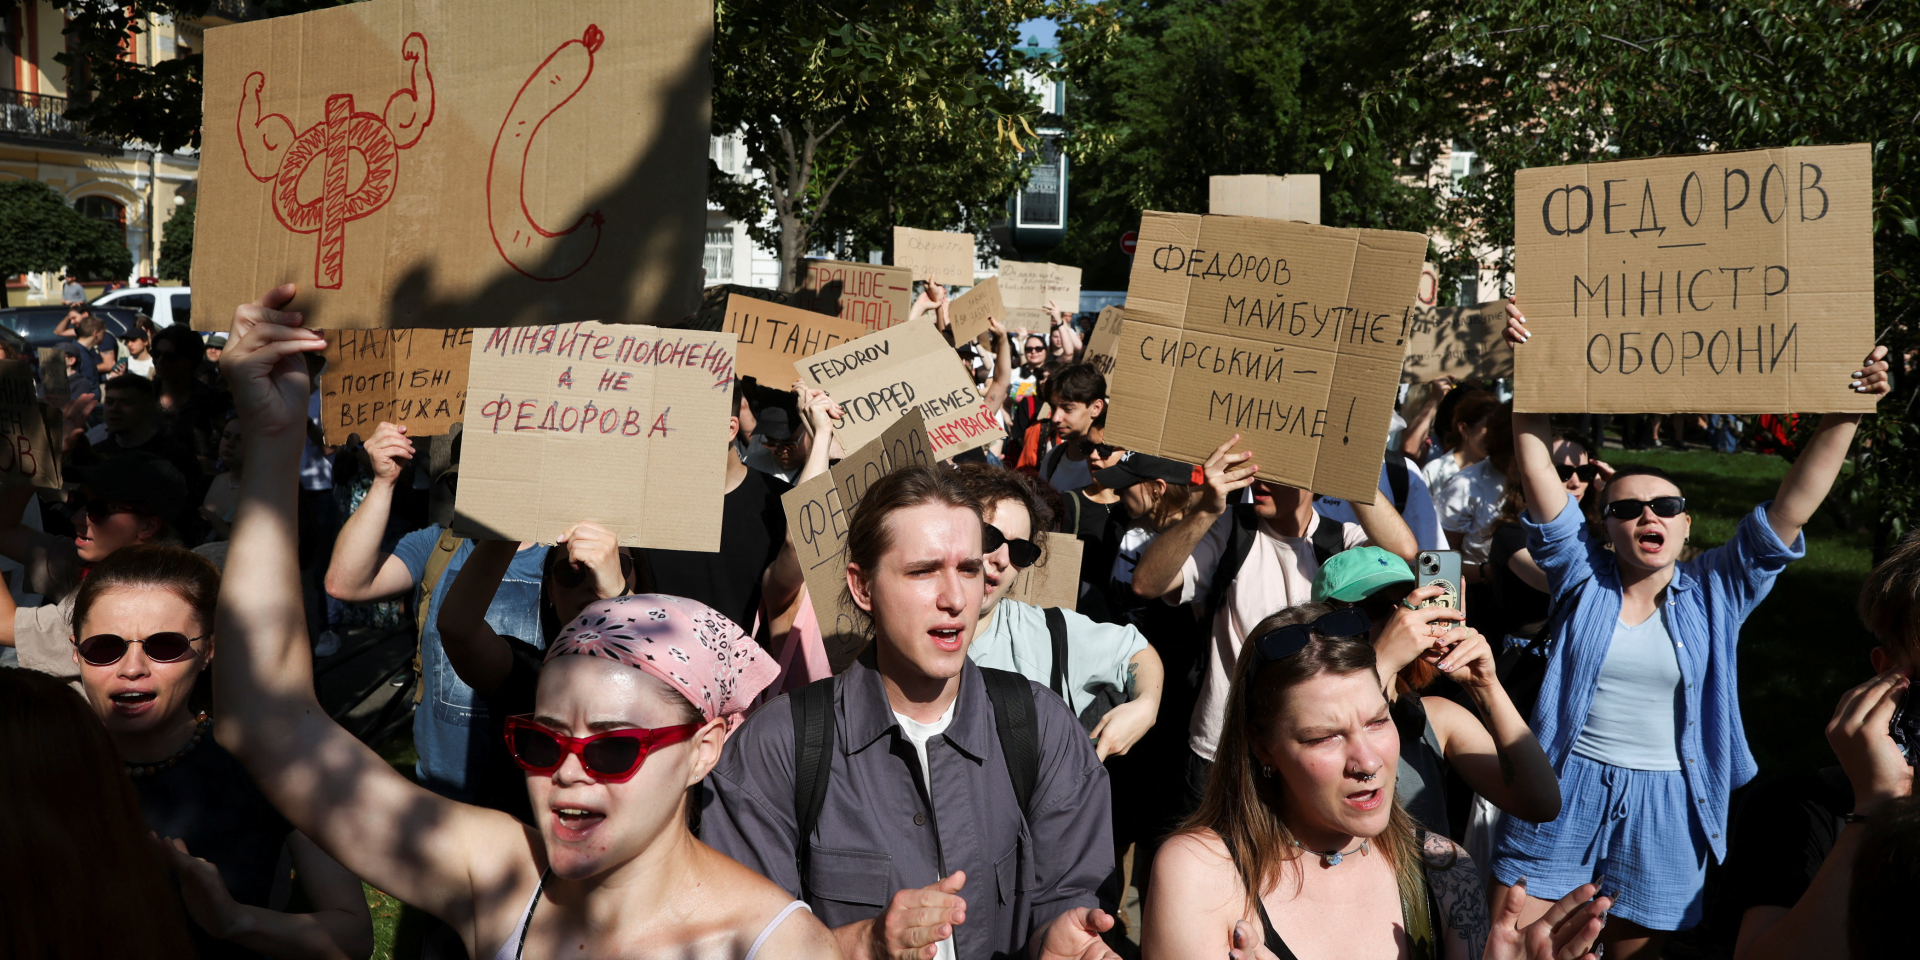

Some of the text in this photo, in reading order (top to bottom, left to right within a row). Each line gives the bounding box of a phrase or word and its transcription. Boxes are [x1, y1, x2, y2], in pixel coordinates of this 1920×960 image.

[1542, 162, 1829, 238] ФЕДОРОВ
[1153, 244, 1291, 286] ФЕДОРОВ
[809, 340, 890, 384] FEDOROV
[1140, 336, 1284, 383] СИРСЬКИЙ
[1586, 323, 1798, 376] ОБОРОНИ
[598, 368, 634, 391] НЕ
[481, 393, 677, 437] ФЕДОРОВА
[900, 386, 976, 430] SHEMES
